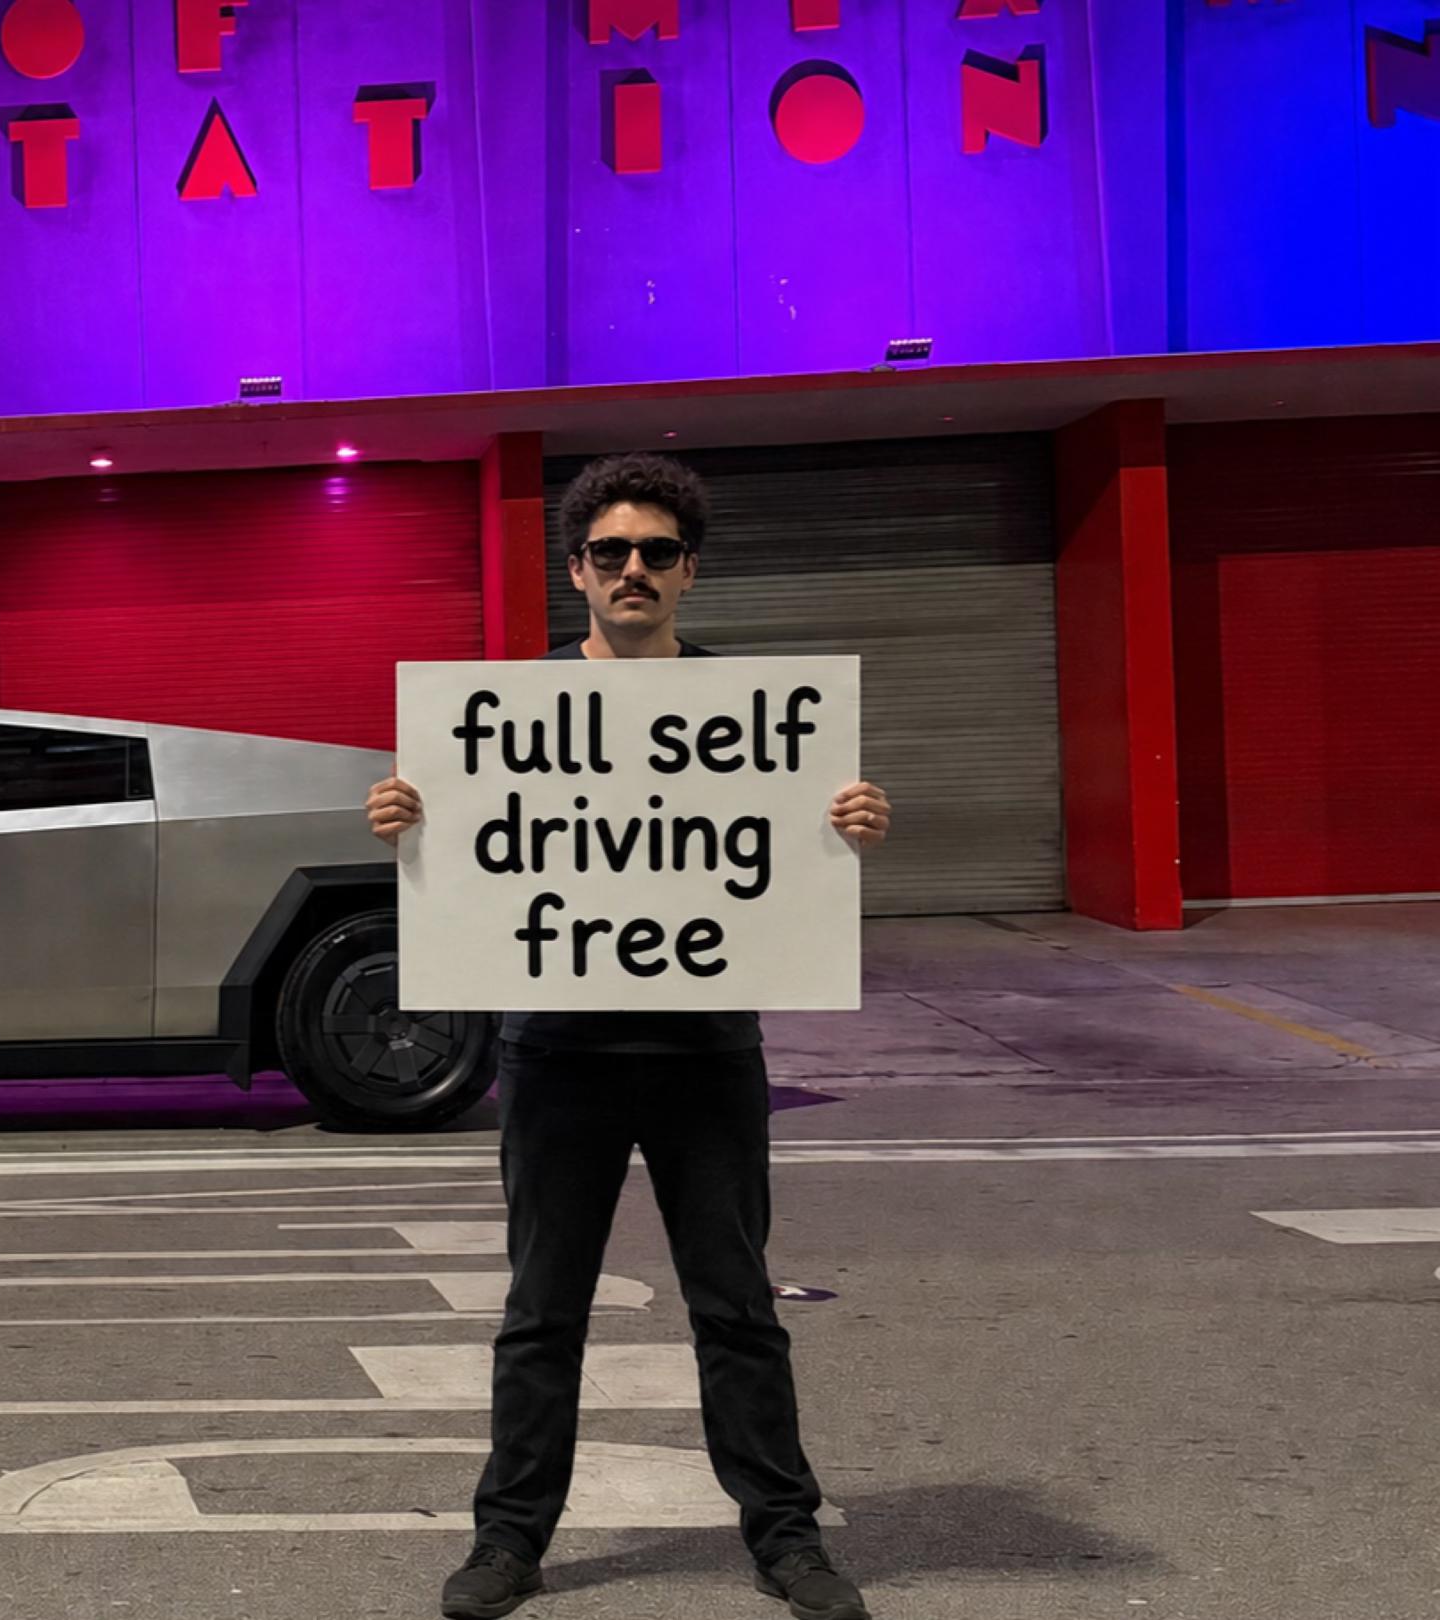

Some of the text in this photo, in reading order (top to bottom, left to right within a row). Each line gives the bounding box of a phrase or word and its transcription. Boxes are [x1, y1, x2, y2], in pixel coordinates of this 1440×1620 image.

[0, 0, 249, 79] OF
[452, 686, 822, 775] full self
[474, 791, 771, 899] driving
[515, 892, 728, 978] free
